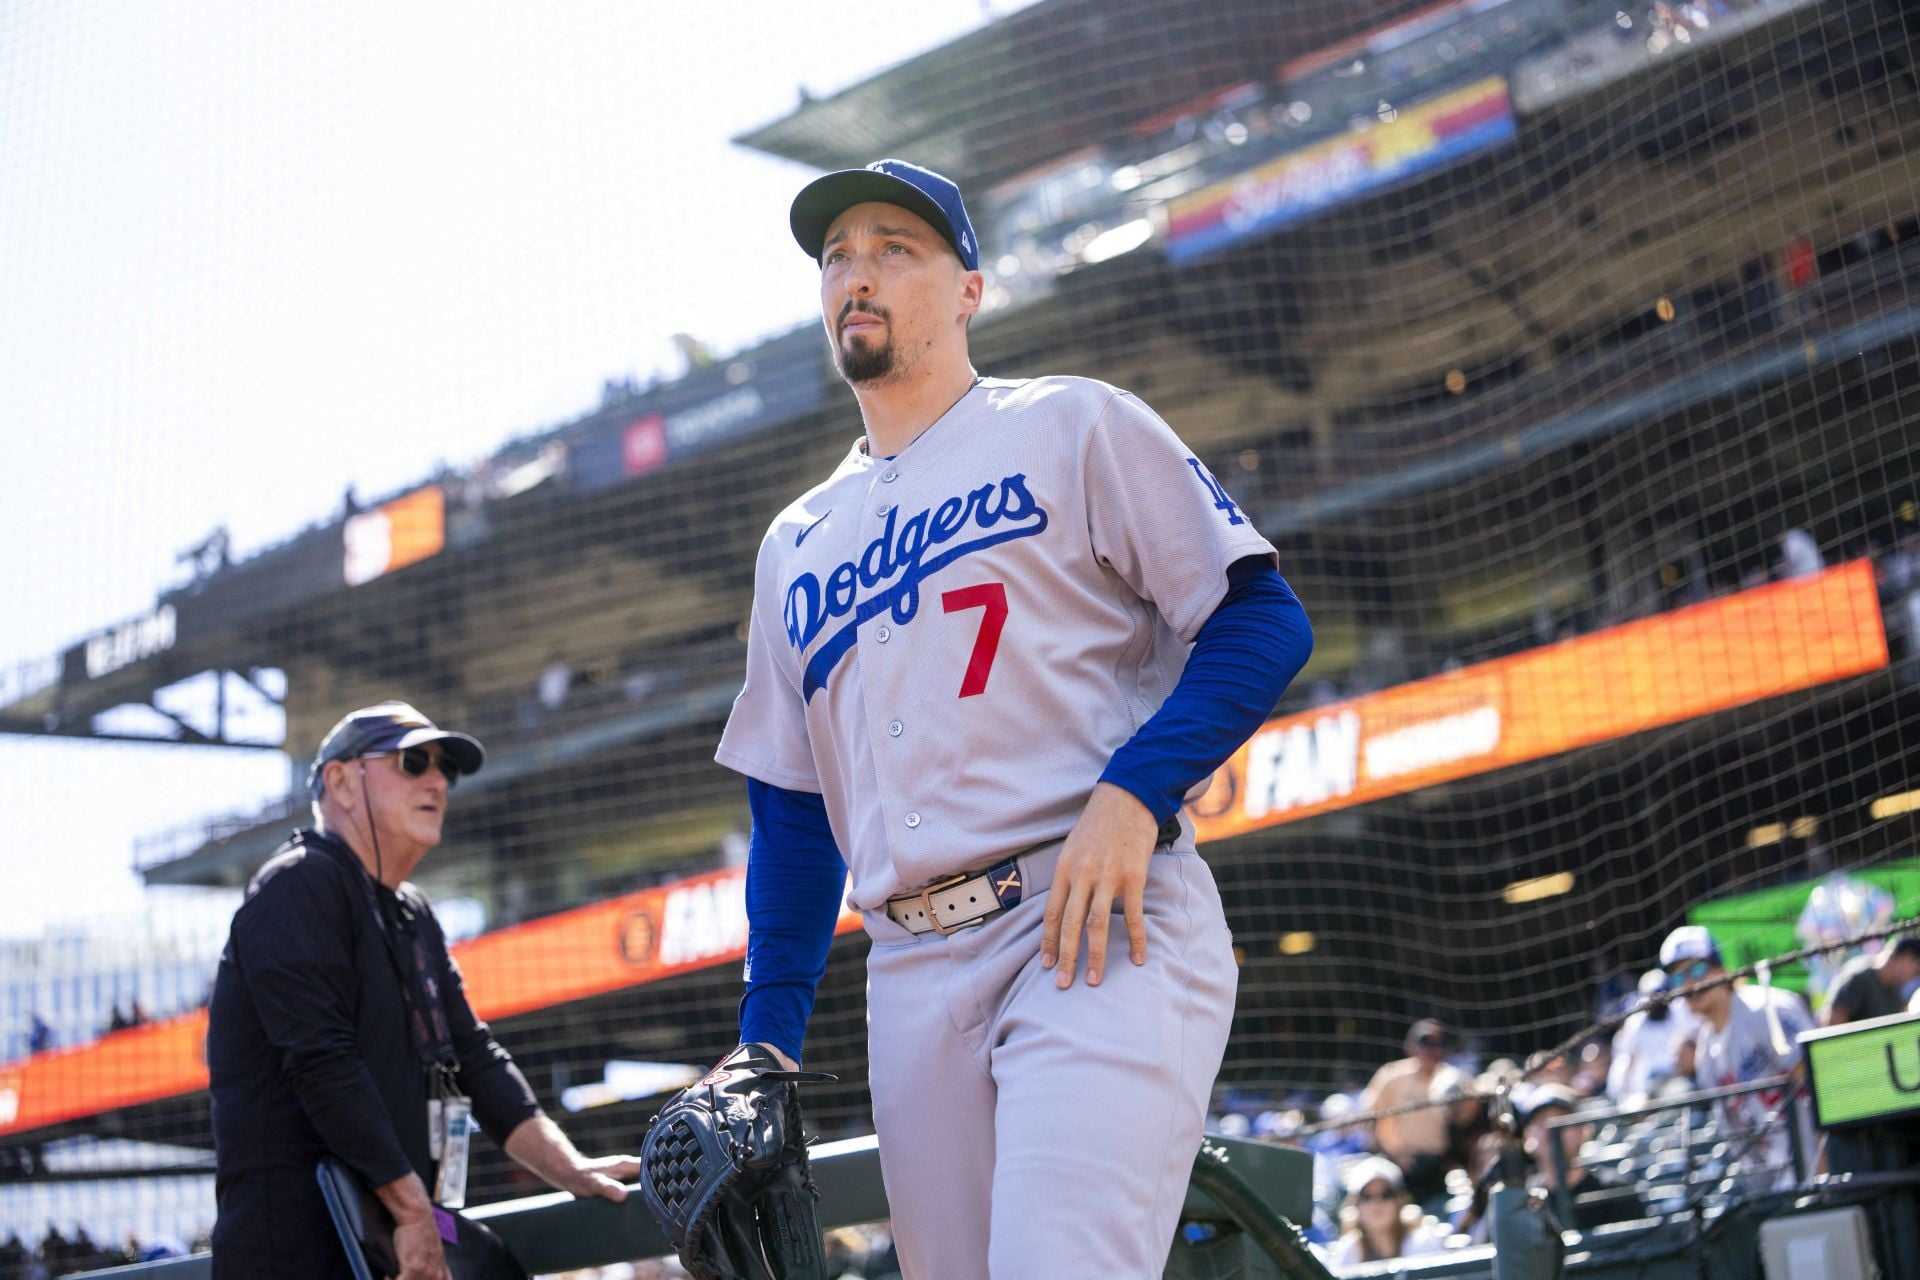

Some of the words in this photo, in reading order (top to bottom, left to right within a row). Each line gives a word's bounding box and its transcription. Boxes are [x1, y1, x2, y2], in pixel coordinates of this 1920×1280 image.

[784, 473, 1038, 656] Dodgers
[941, 582, 1009, 698] 7
[1245, 710, 1361, 819] FAN
